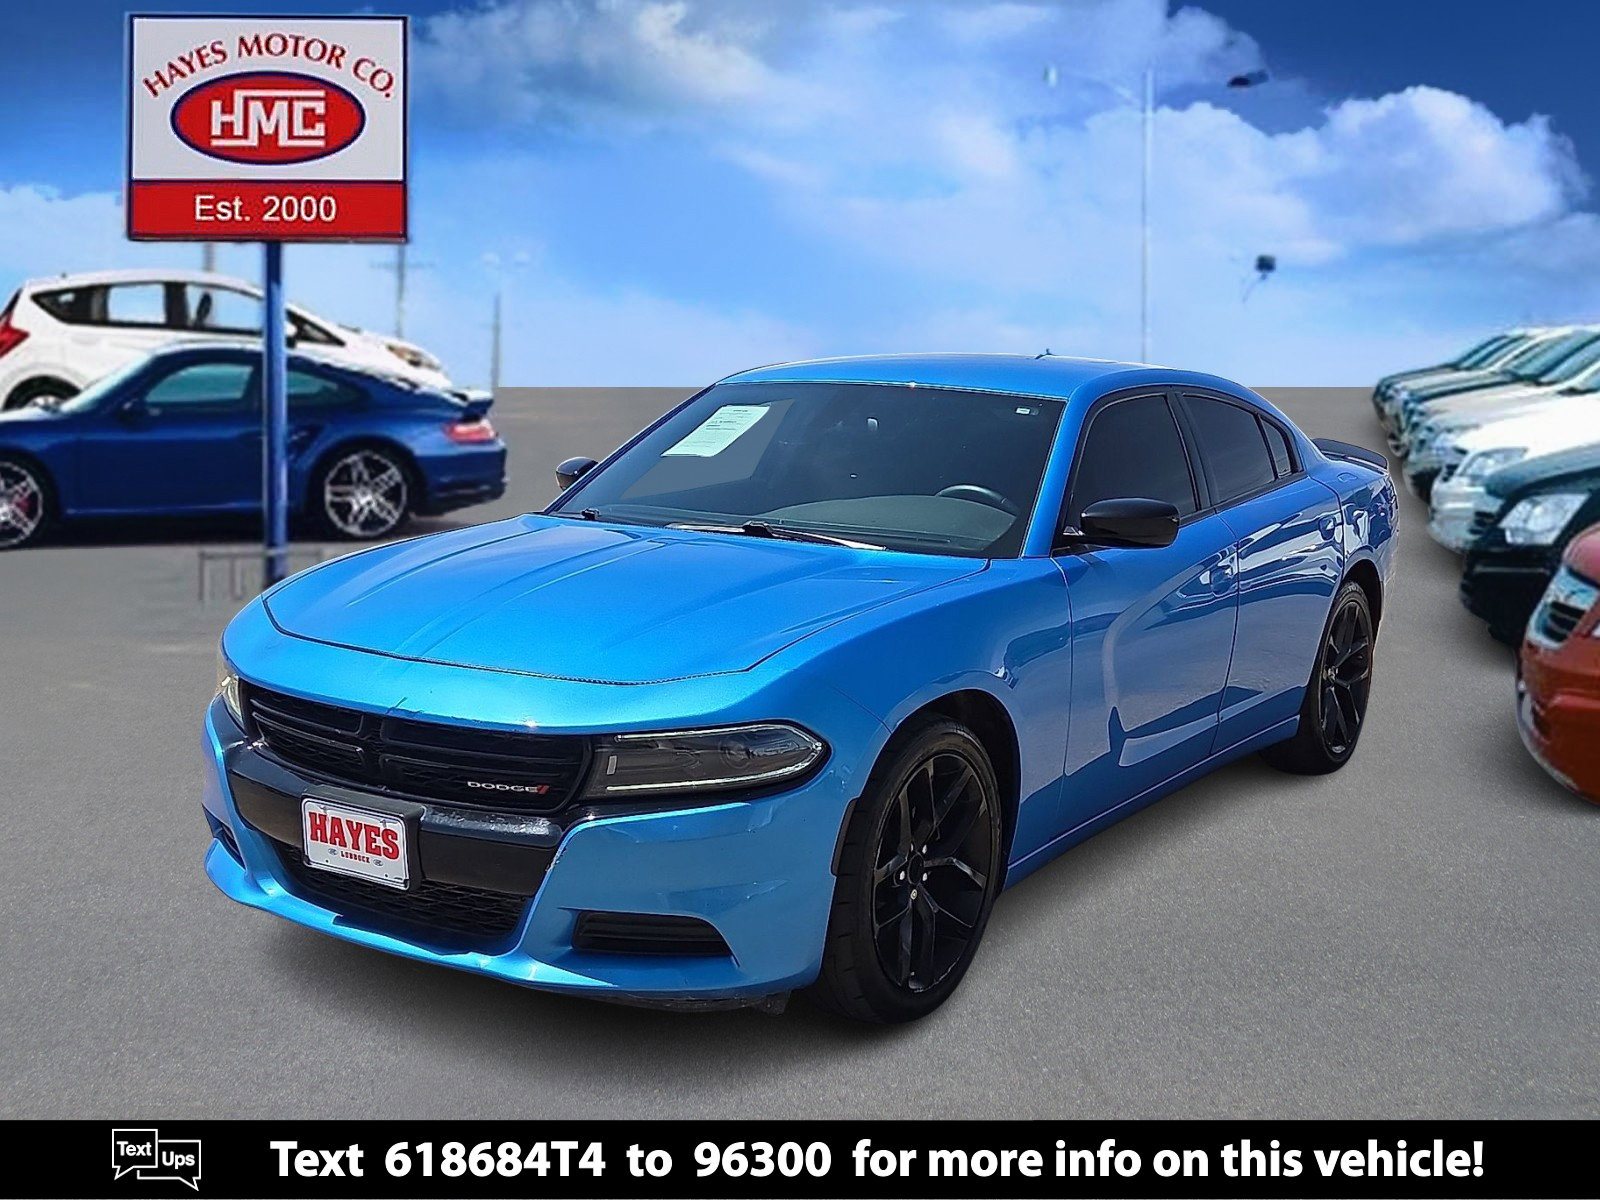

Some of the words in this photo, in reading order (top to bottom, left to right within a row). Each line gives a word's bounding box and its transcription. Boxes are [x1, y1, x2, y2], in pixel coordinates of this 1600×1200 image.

[142, 40, 228, 98] HAYES
[237, 32, 347, 70] MOTOR
[352, 57, 394, 99] CO.
[210, 88, 326, 148] HMC
[194, 193, 250, 222] Est.
[262, 195, 337, 222] 2000
[467, 781, 539, 793] DODGE
[308, 811, 400, 860] HAYES
